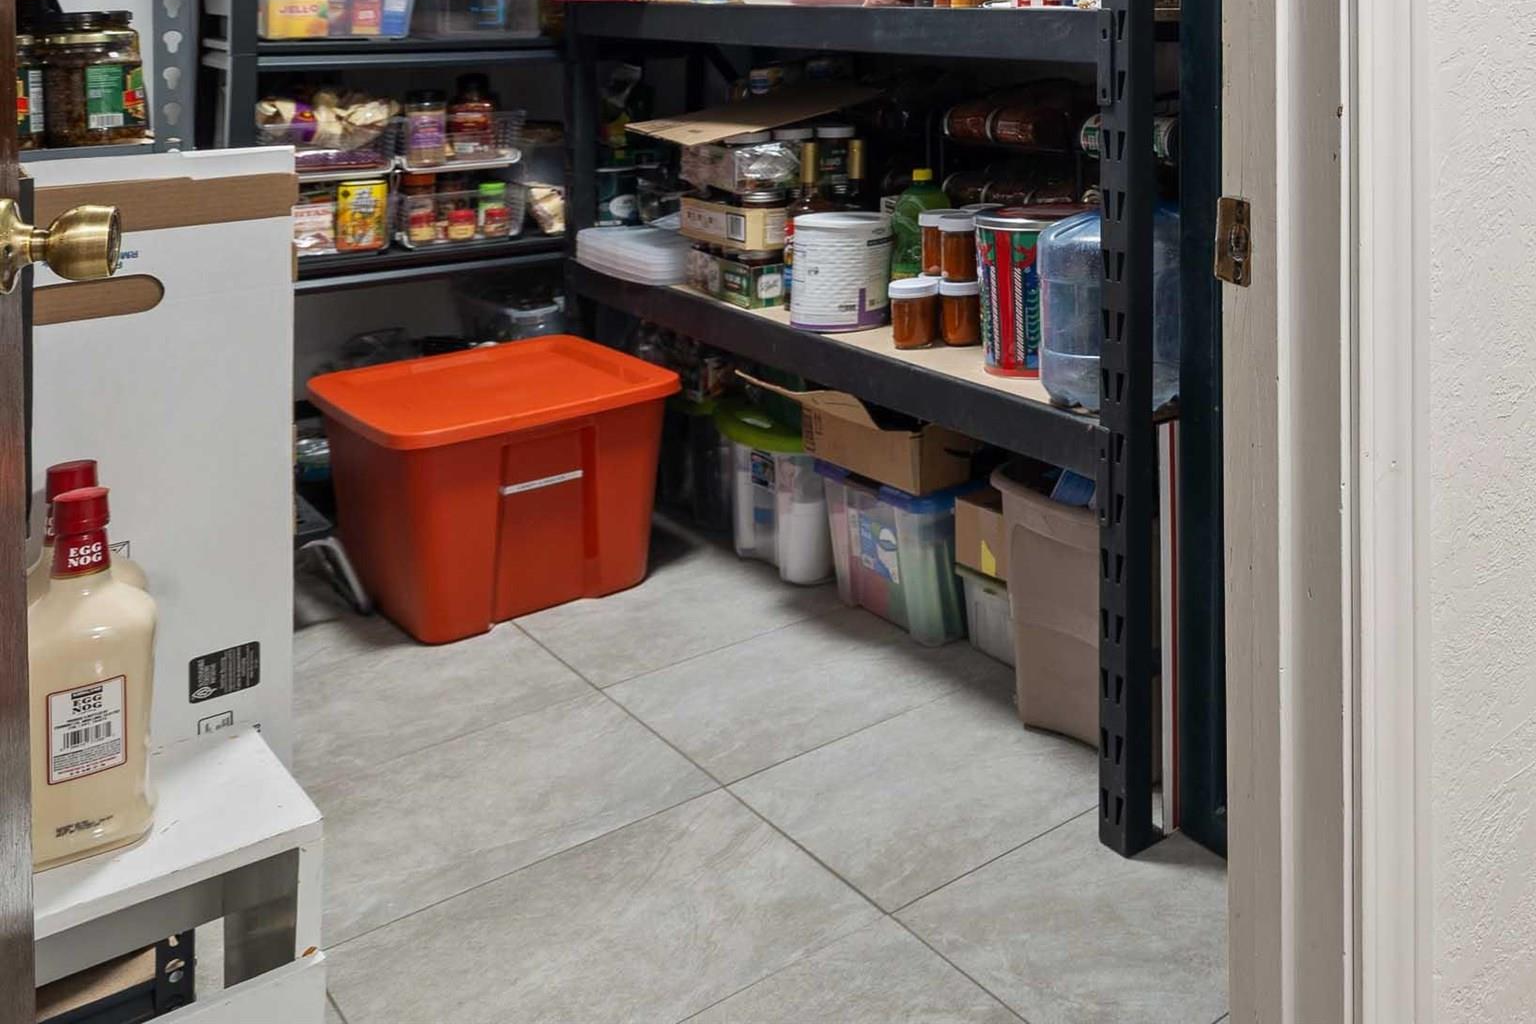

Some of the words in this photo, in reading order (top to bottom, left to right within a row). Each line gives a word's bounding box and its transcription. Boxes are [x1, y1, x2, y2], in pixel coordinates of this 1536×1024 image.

[69, 542, 102, 558] EGG
[67, 552, 102, 568] NOG
[72, 701, 102, 715] NOG
[73, 694, 102, 707] EGG
